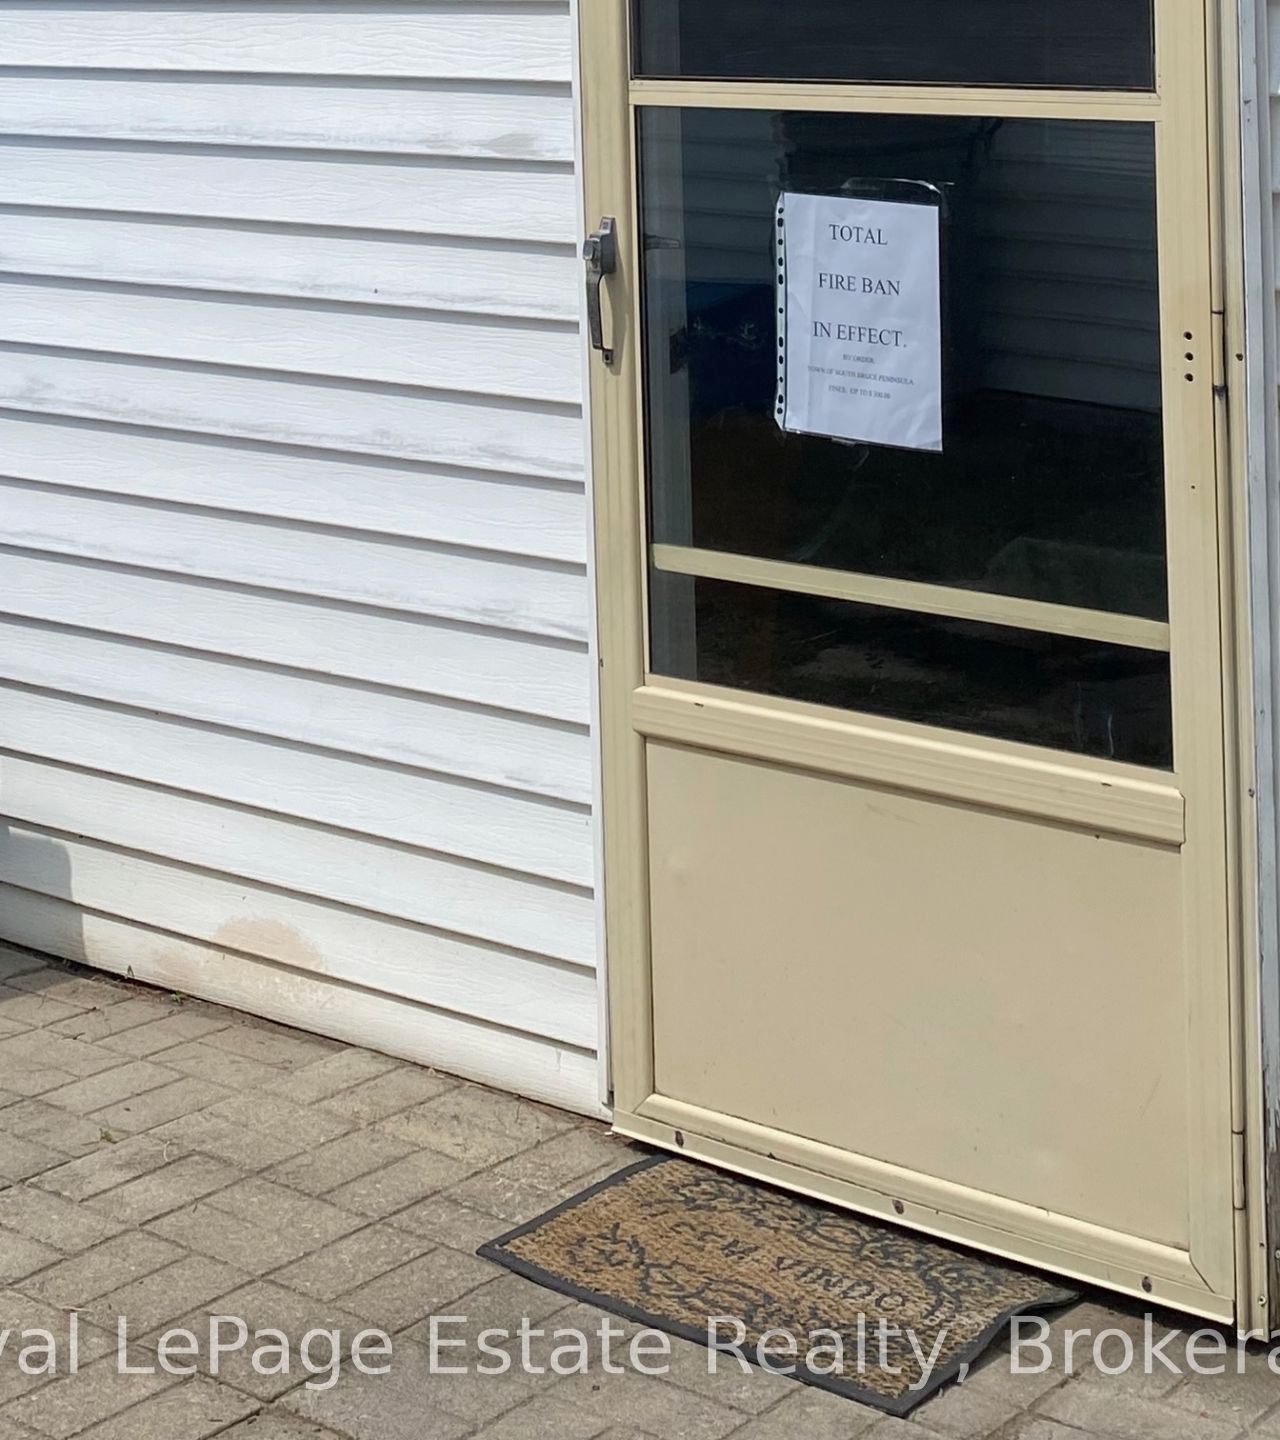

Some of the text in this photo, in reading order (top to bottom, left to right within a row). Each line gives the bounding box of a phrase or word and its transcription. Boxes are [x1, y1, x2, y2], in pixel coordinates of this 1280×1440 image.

[828, 223, 889, 246] TOTAL
[819, 272, 901, 296] FIRE BAN
[813, 320, 908, 348] IN EFFECT.
